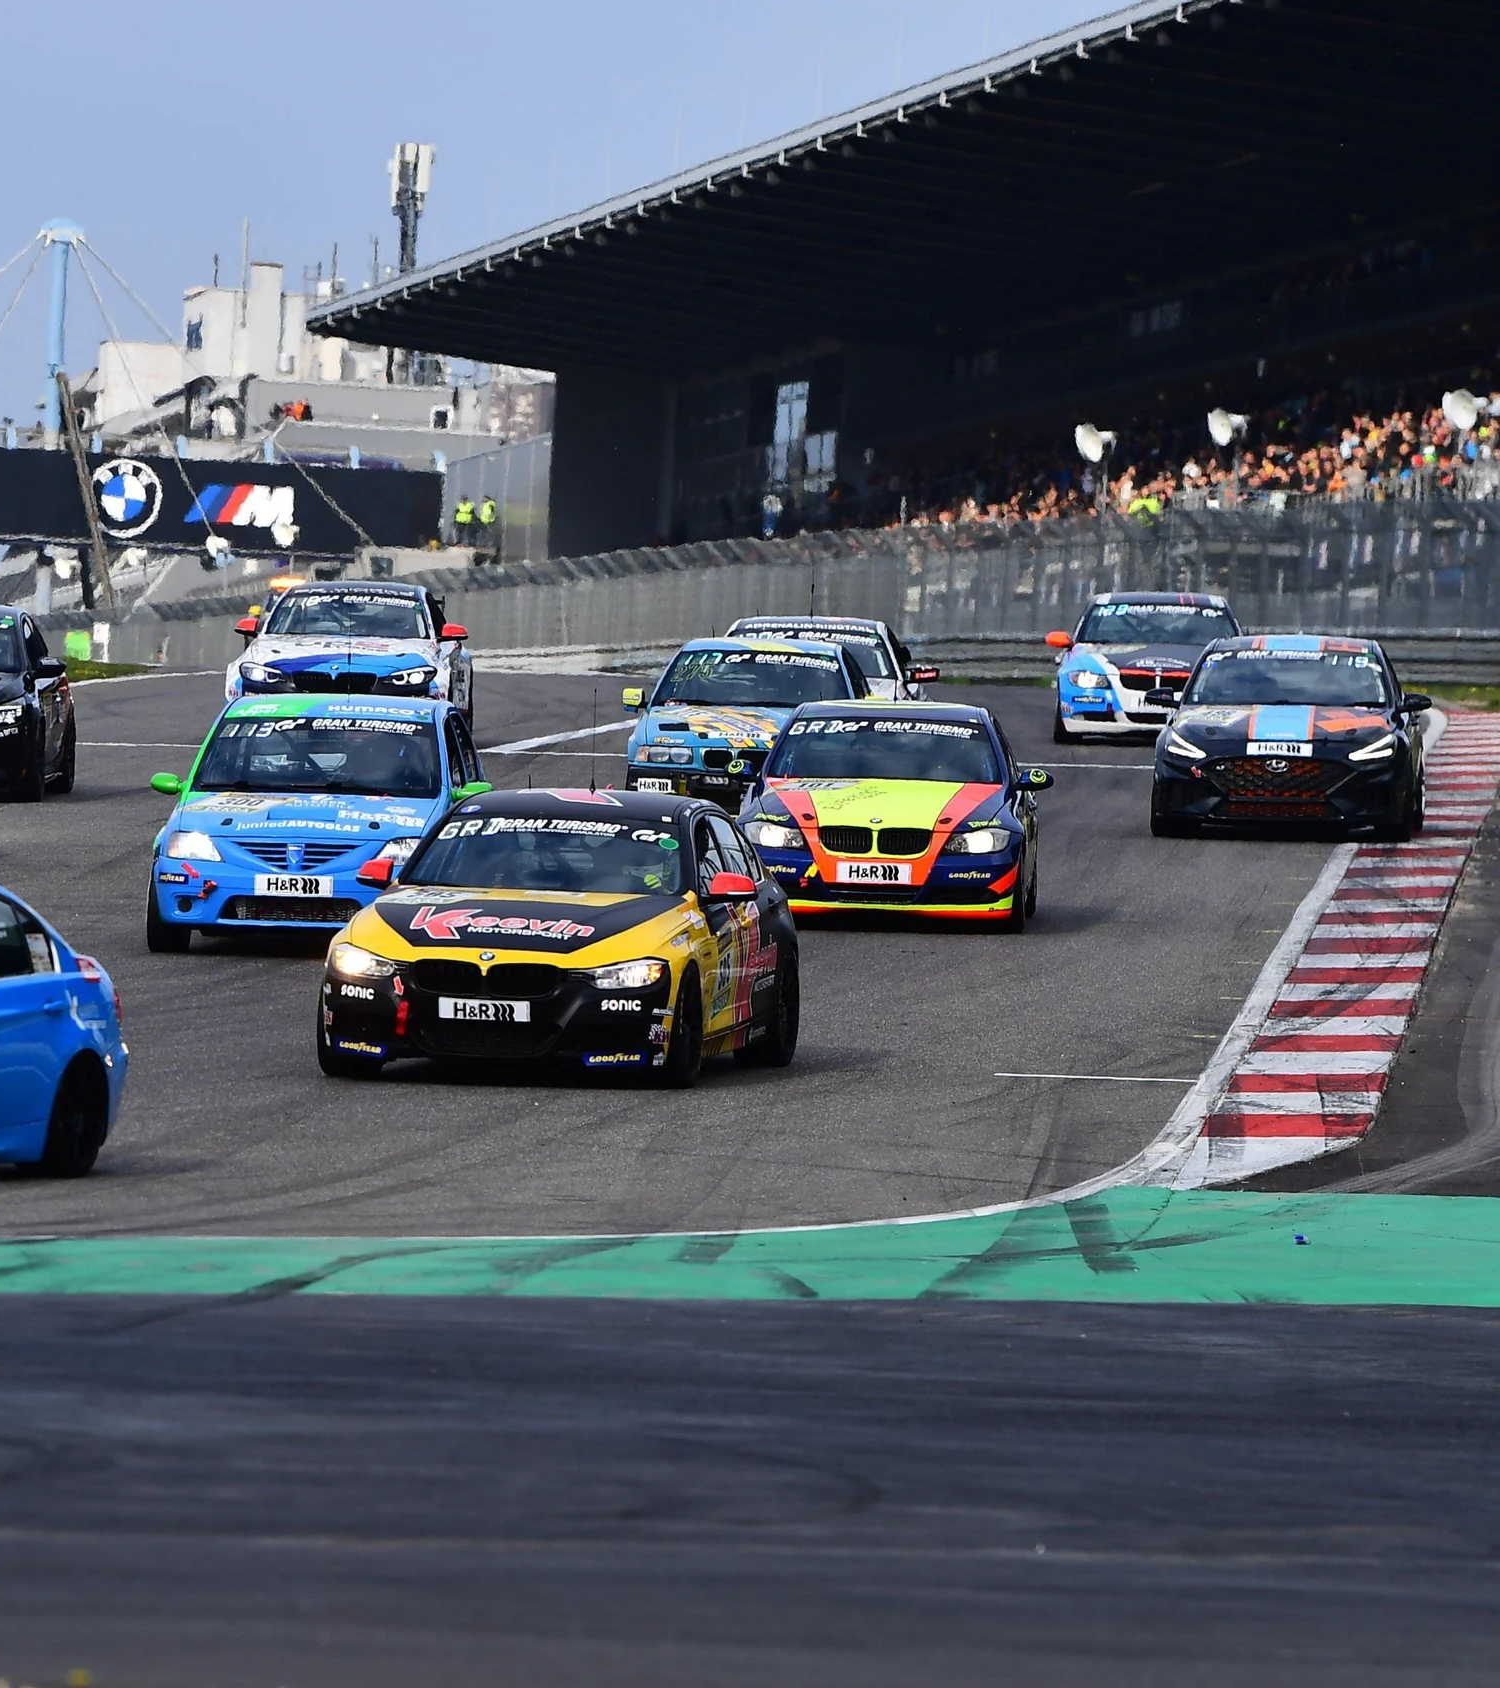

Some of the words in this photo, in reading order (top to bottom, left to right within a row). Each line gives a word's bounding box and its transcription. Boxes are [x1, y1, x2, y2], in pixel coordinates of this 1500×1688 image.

[343, 595, 371, 604] GRAN
[373, 596, 415, 607] TURISMO
[798, 631, 830, 641] GRAN
[831, 633, 878, 646] TURISMO
[684, 652, 723, 666] 117
[755, 653, 786, 663] GRAN
[789, 655, 839, 671] TURISMO
[1237, 650, 1270, 660] GRAN
[671, 663, 714, 683] 275
[227, 722, 274, 738] 113
[311, 718, 352, 728] GRAN
[354, 720, 417, 733] TURISMO
[788, 720, 843, 736] GRD
[873, 721, 912, 731] GRAN
[914, 722, 974, 735] TURISMO
[639, 780, 658, 789] H&R
[438, 817, 503, 840] GRD
[500, 818, 546, 829] GRAN
[548, 819, 623, 834] TURISMO
[848, 865, 879, 879] H&R
[948, 871, 991, 880] GOODYEAR
[266, 877, 299, 892] H&R
[467, 926, 573, 941] MOTORSPORT
[452, 1002, 492, 1018] H&R
[338, 1039, 382, 1054] GOODYEAR
[589, 1053, 641, 1063] GOODYEAR
